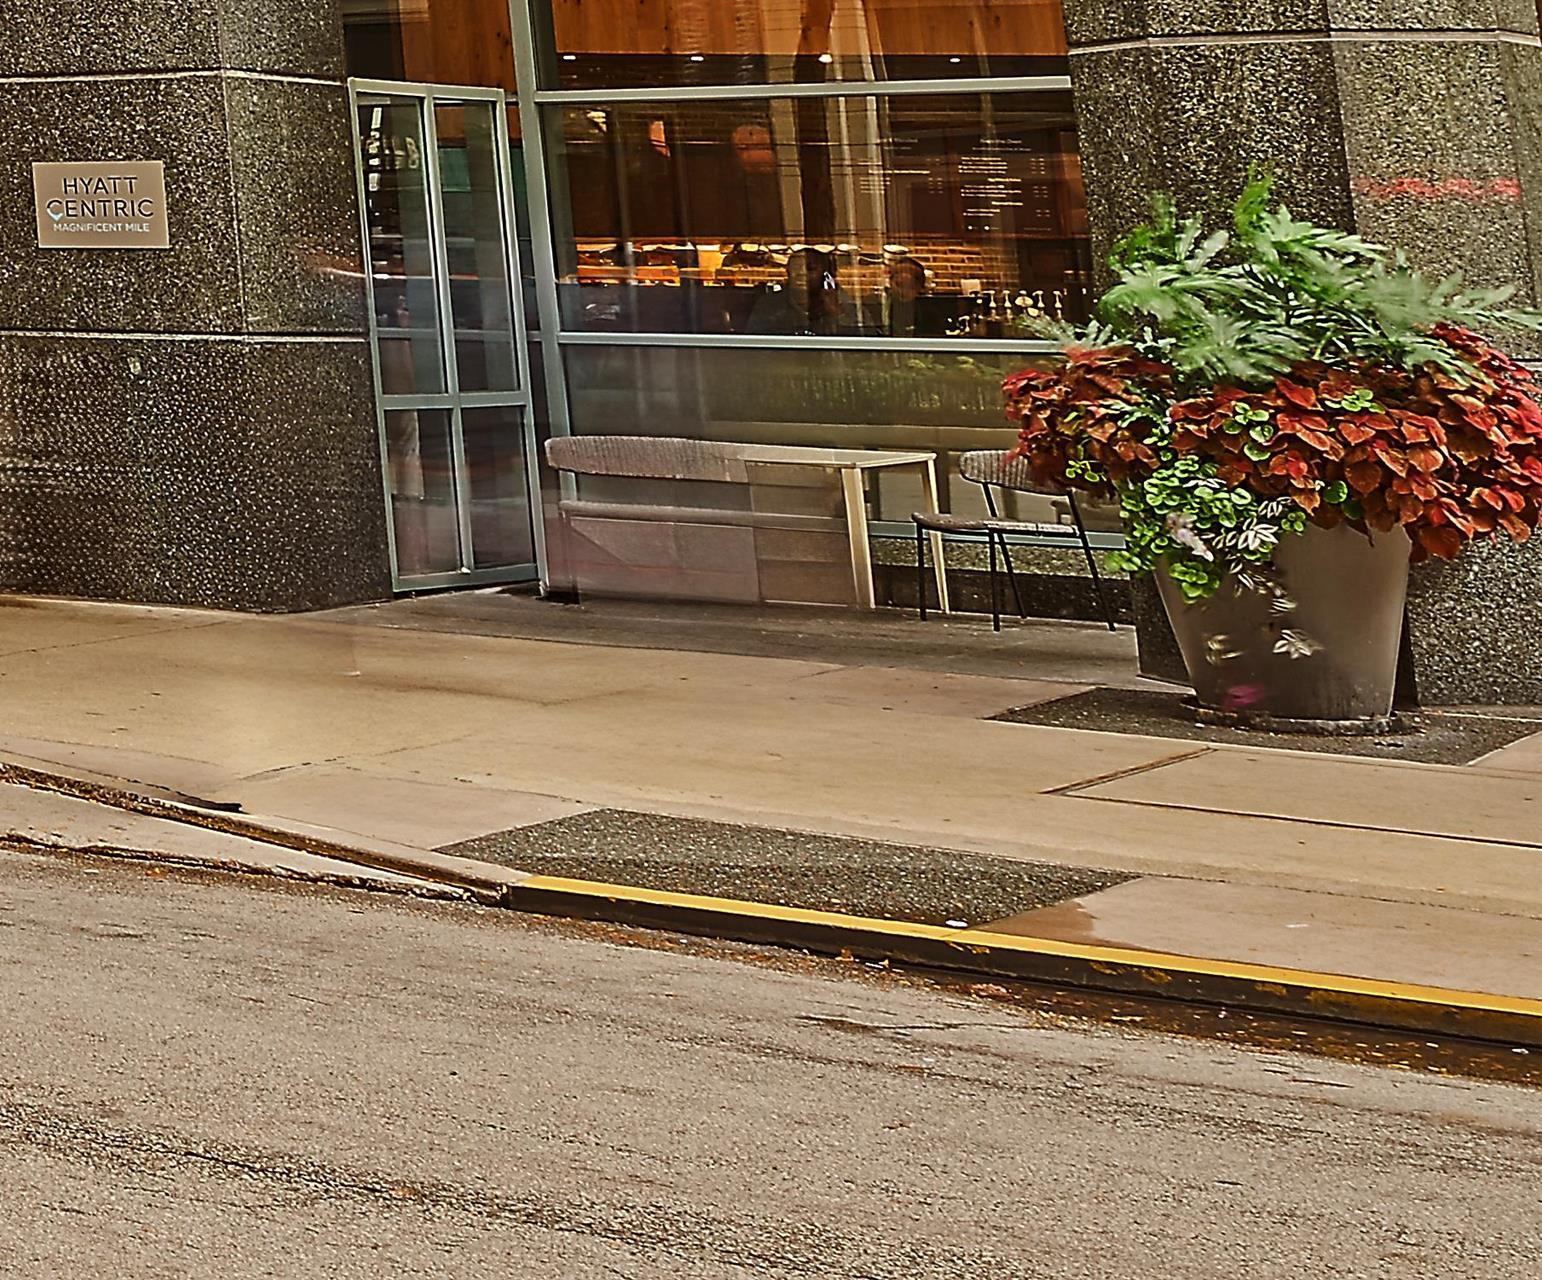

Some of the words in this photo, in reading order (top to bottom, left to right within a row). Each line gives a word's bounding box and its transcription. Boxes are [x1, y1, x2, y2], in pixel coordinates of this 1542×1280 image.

[62, 176, 137, 195] HYATT
[46, 199, 154, 220] CENTRIC
[53, 223, 122, 232] MAGNIFICENT
[125, 223, 150, 232] MILE
